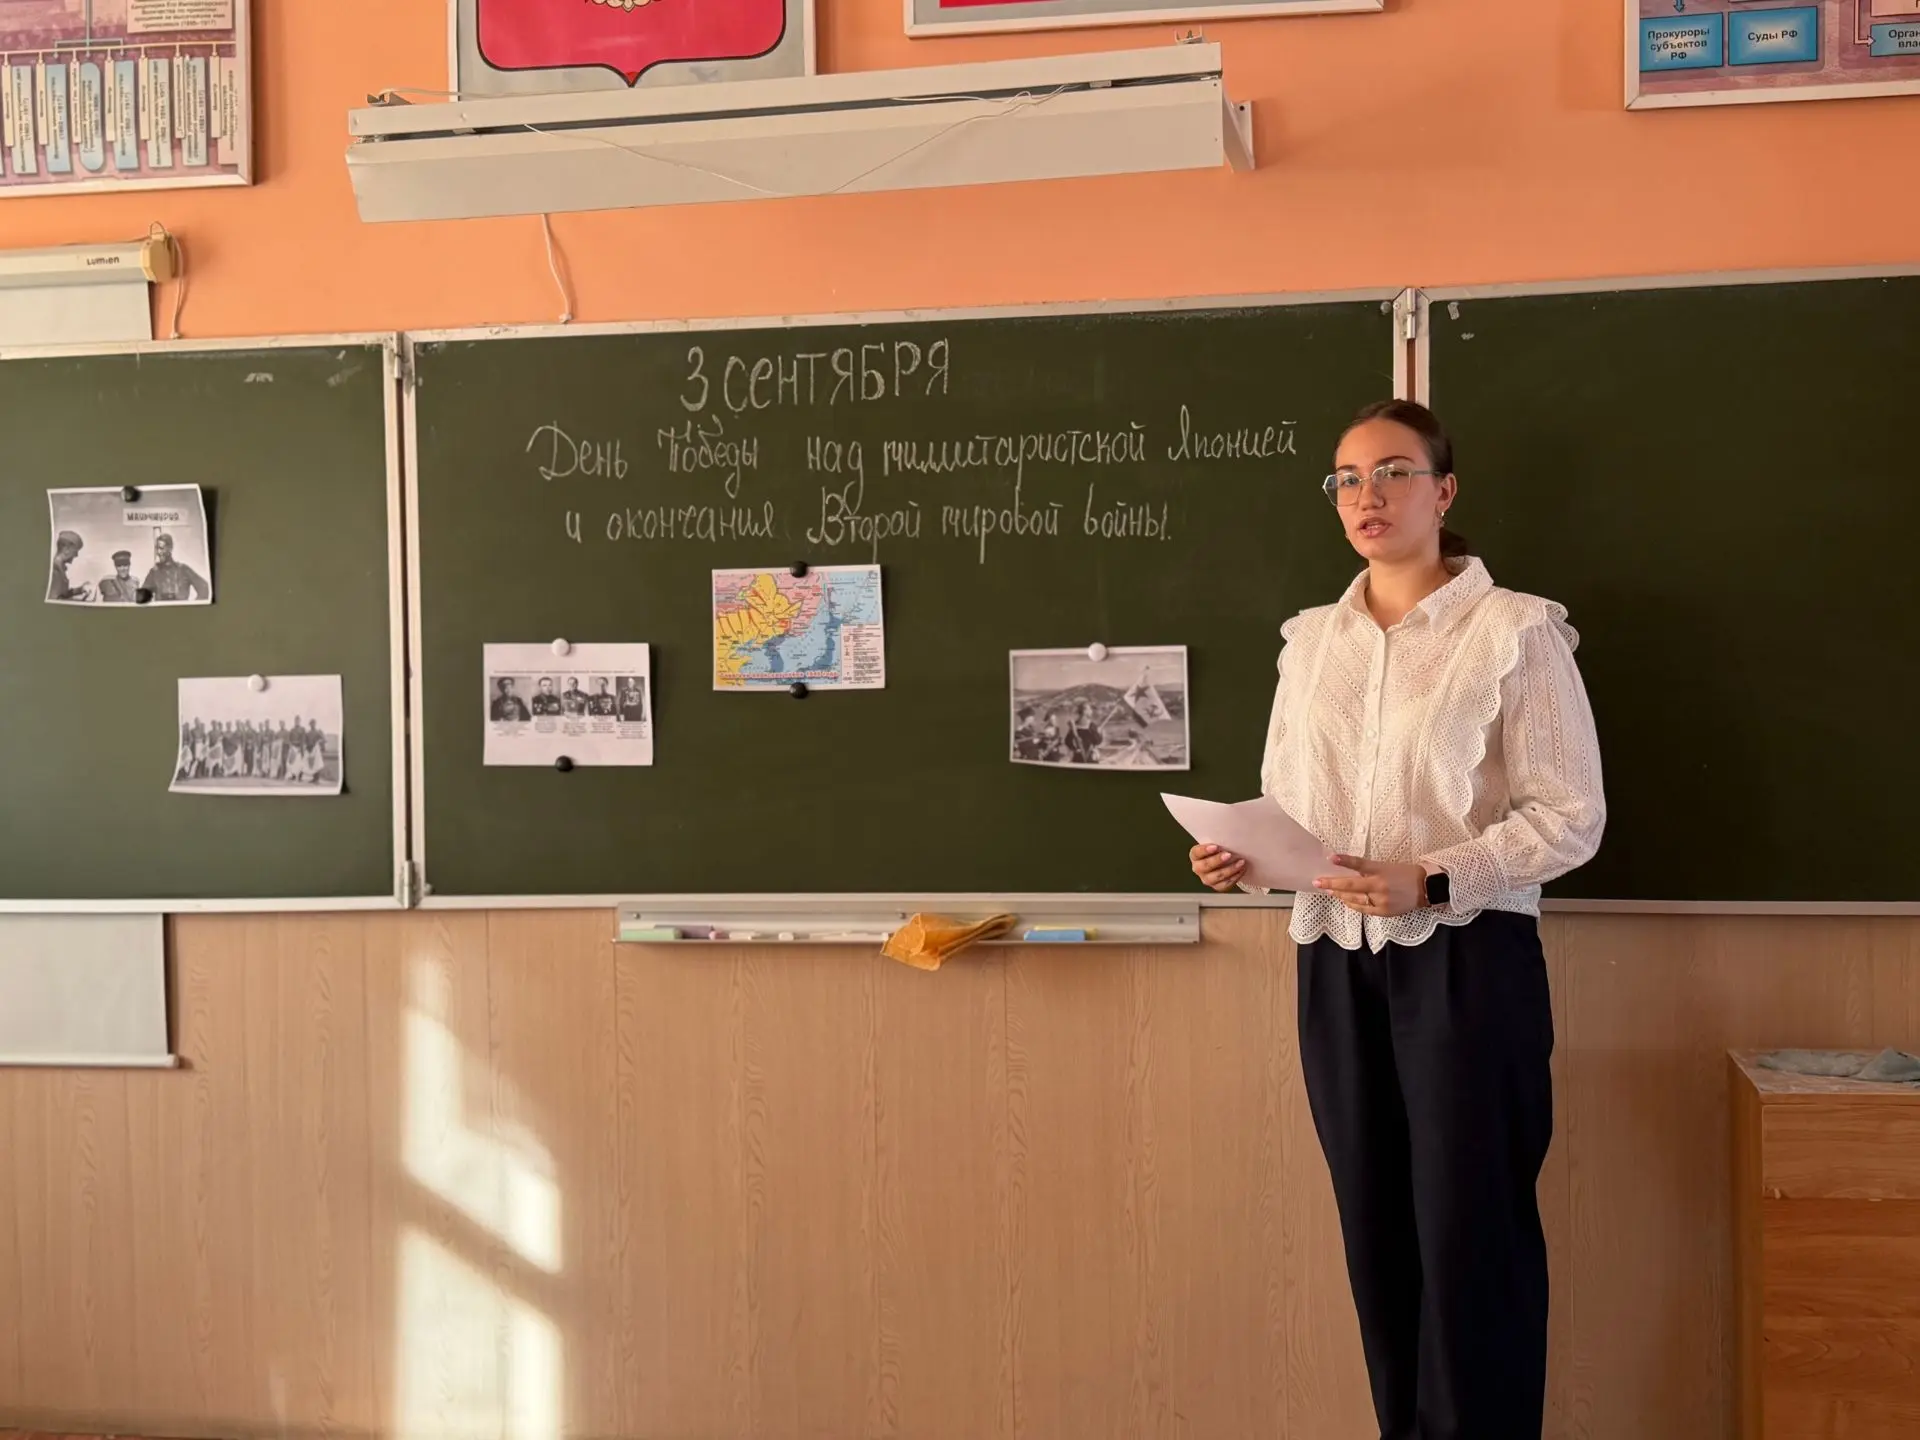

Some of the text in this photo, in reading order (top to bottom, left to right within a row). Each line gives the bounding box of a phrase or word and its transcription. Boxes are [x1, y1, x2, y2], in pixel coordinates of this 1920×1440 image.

[1647, 28, 1710, 41] Прокуроры
[1747, 29, 1799, 43] Суды РФ
[1650, 40, 1707, 52] субъектов
[1670, 51, 1687, 61] РФ
[680, 346, 709, 412] 3
[526, 421, 628, 481] День
[657, 414, 758, 499] Победы
[806, 435, 865, 516] над
[1167, 404, 1297, 462] Японией
[565, 482, 1172, 565] и окончания Второй мировой войны.
